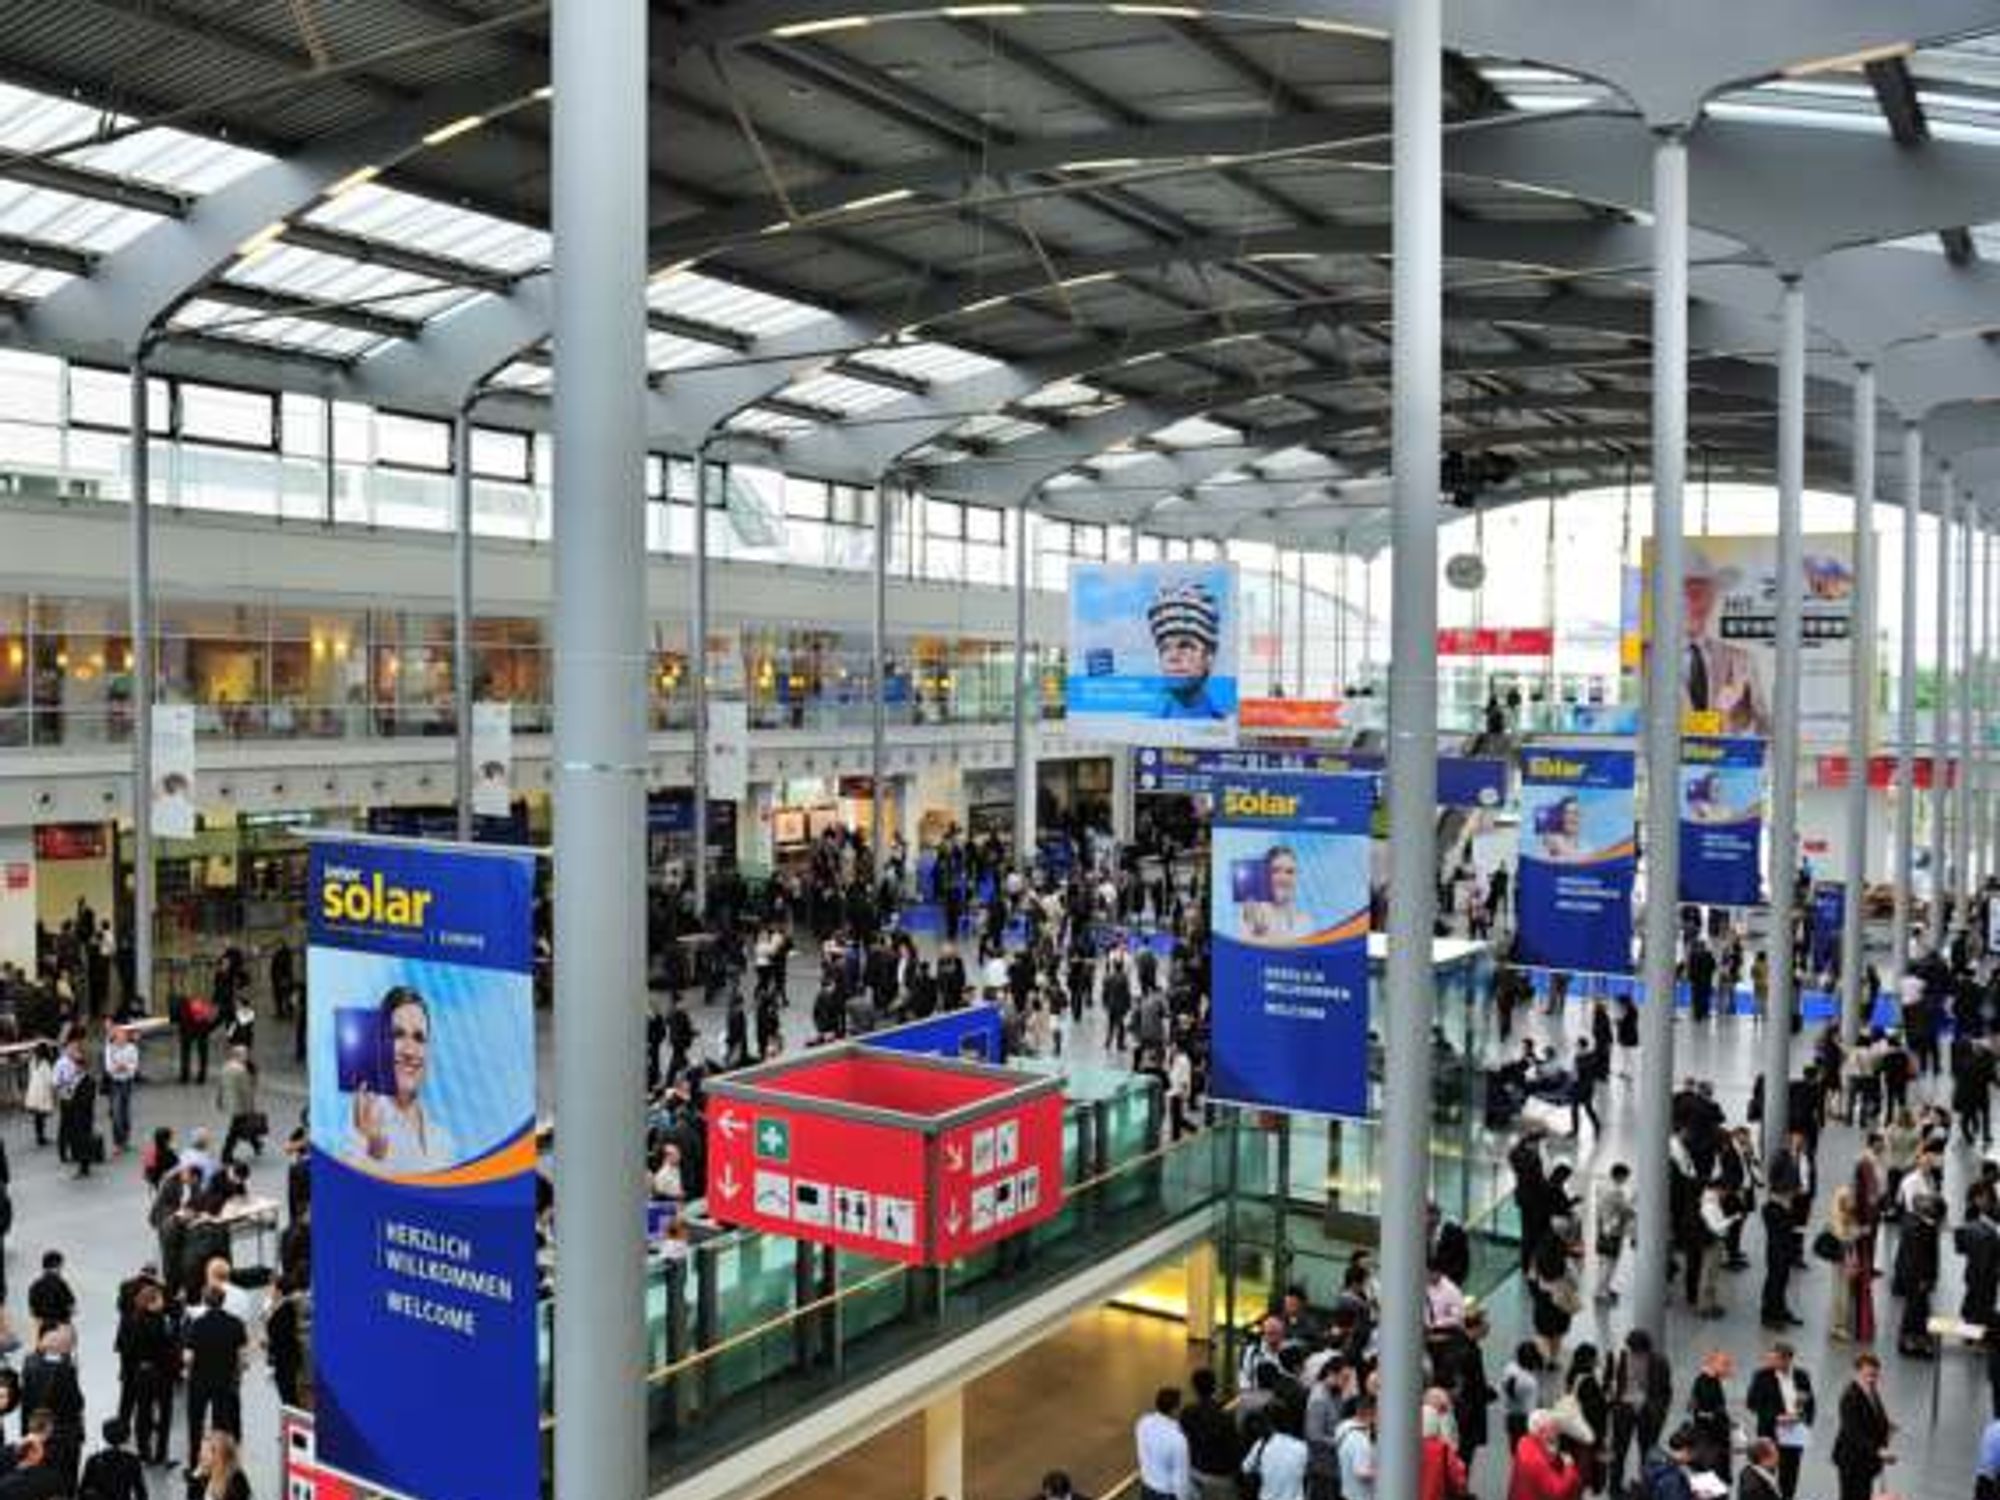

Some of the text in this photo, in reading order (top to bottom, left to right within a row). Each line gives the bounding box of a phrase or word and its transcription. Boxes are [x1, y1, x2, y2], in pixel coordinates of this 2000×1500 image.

[323, 873, 432, 928] solar
[386, 1221, 471, 1262] HERZLICH
[385, 1248, 513, 1302] WILLKOMMEN
[386, 1289, 476, 1336] WELCOME
